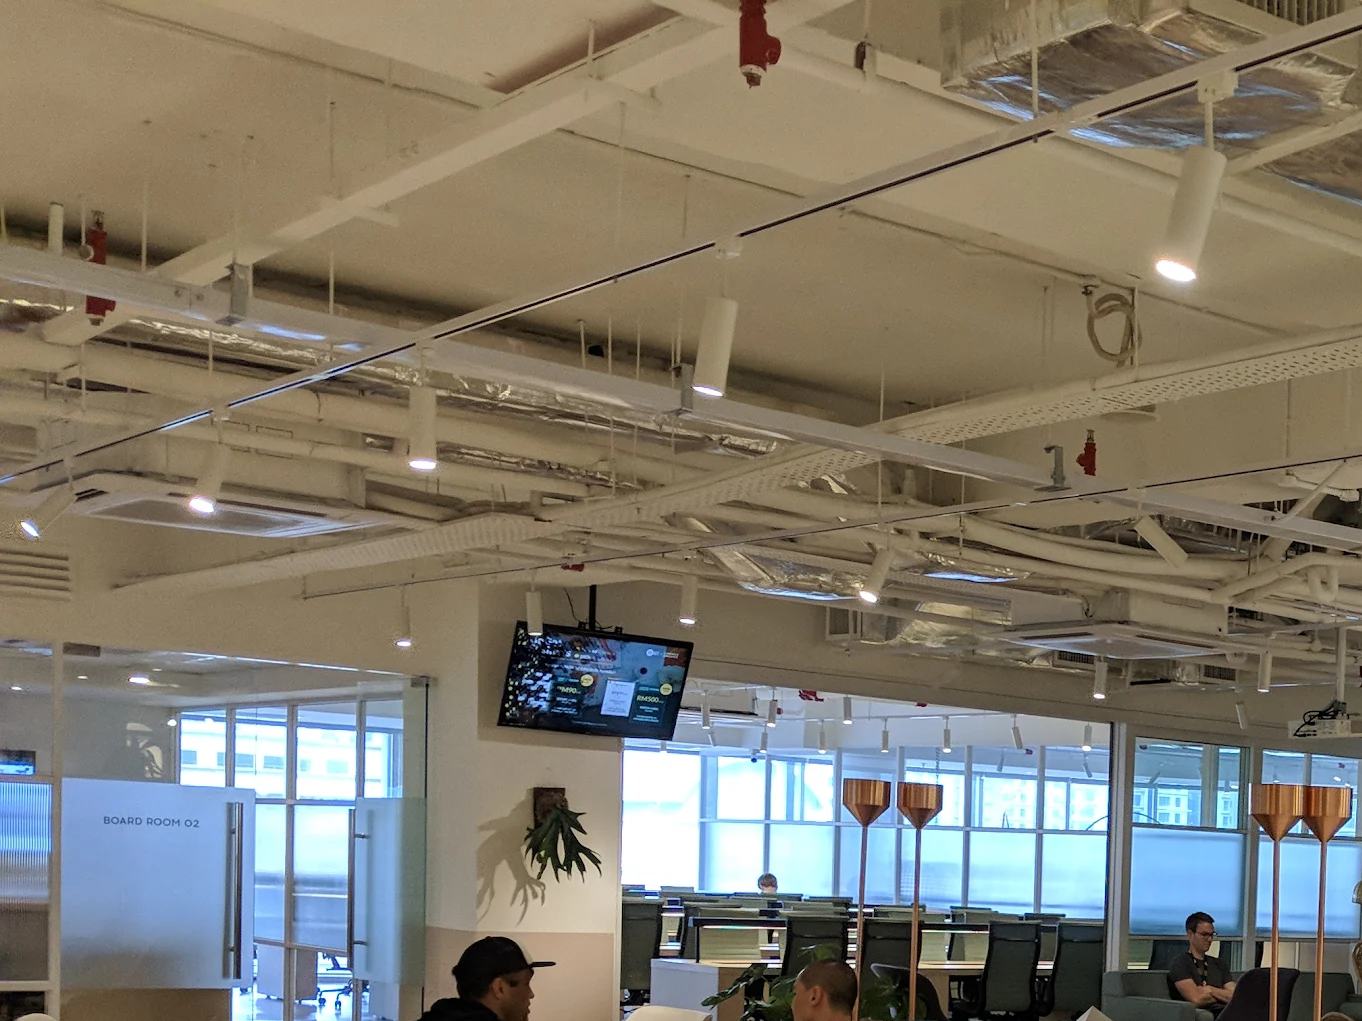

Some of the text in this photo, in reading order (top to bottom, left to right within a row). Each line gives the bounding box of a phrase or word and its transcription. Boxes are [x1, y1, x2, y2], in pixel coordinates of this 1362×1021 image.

[636, 695, 660, 704] RM500
[103, 816, 143, 825] BOARD
[146, 817, 181, 827] ROOM
